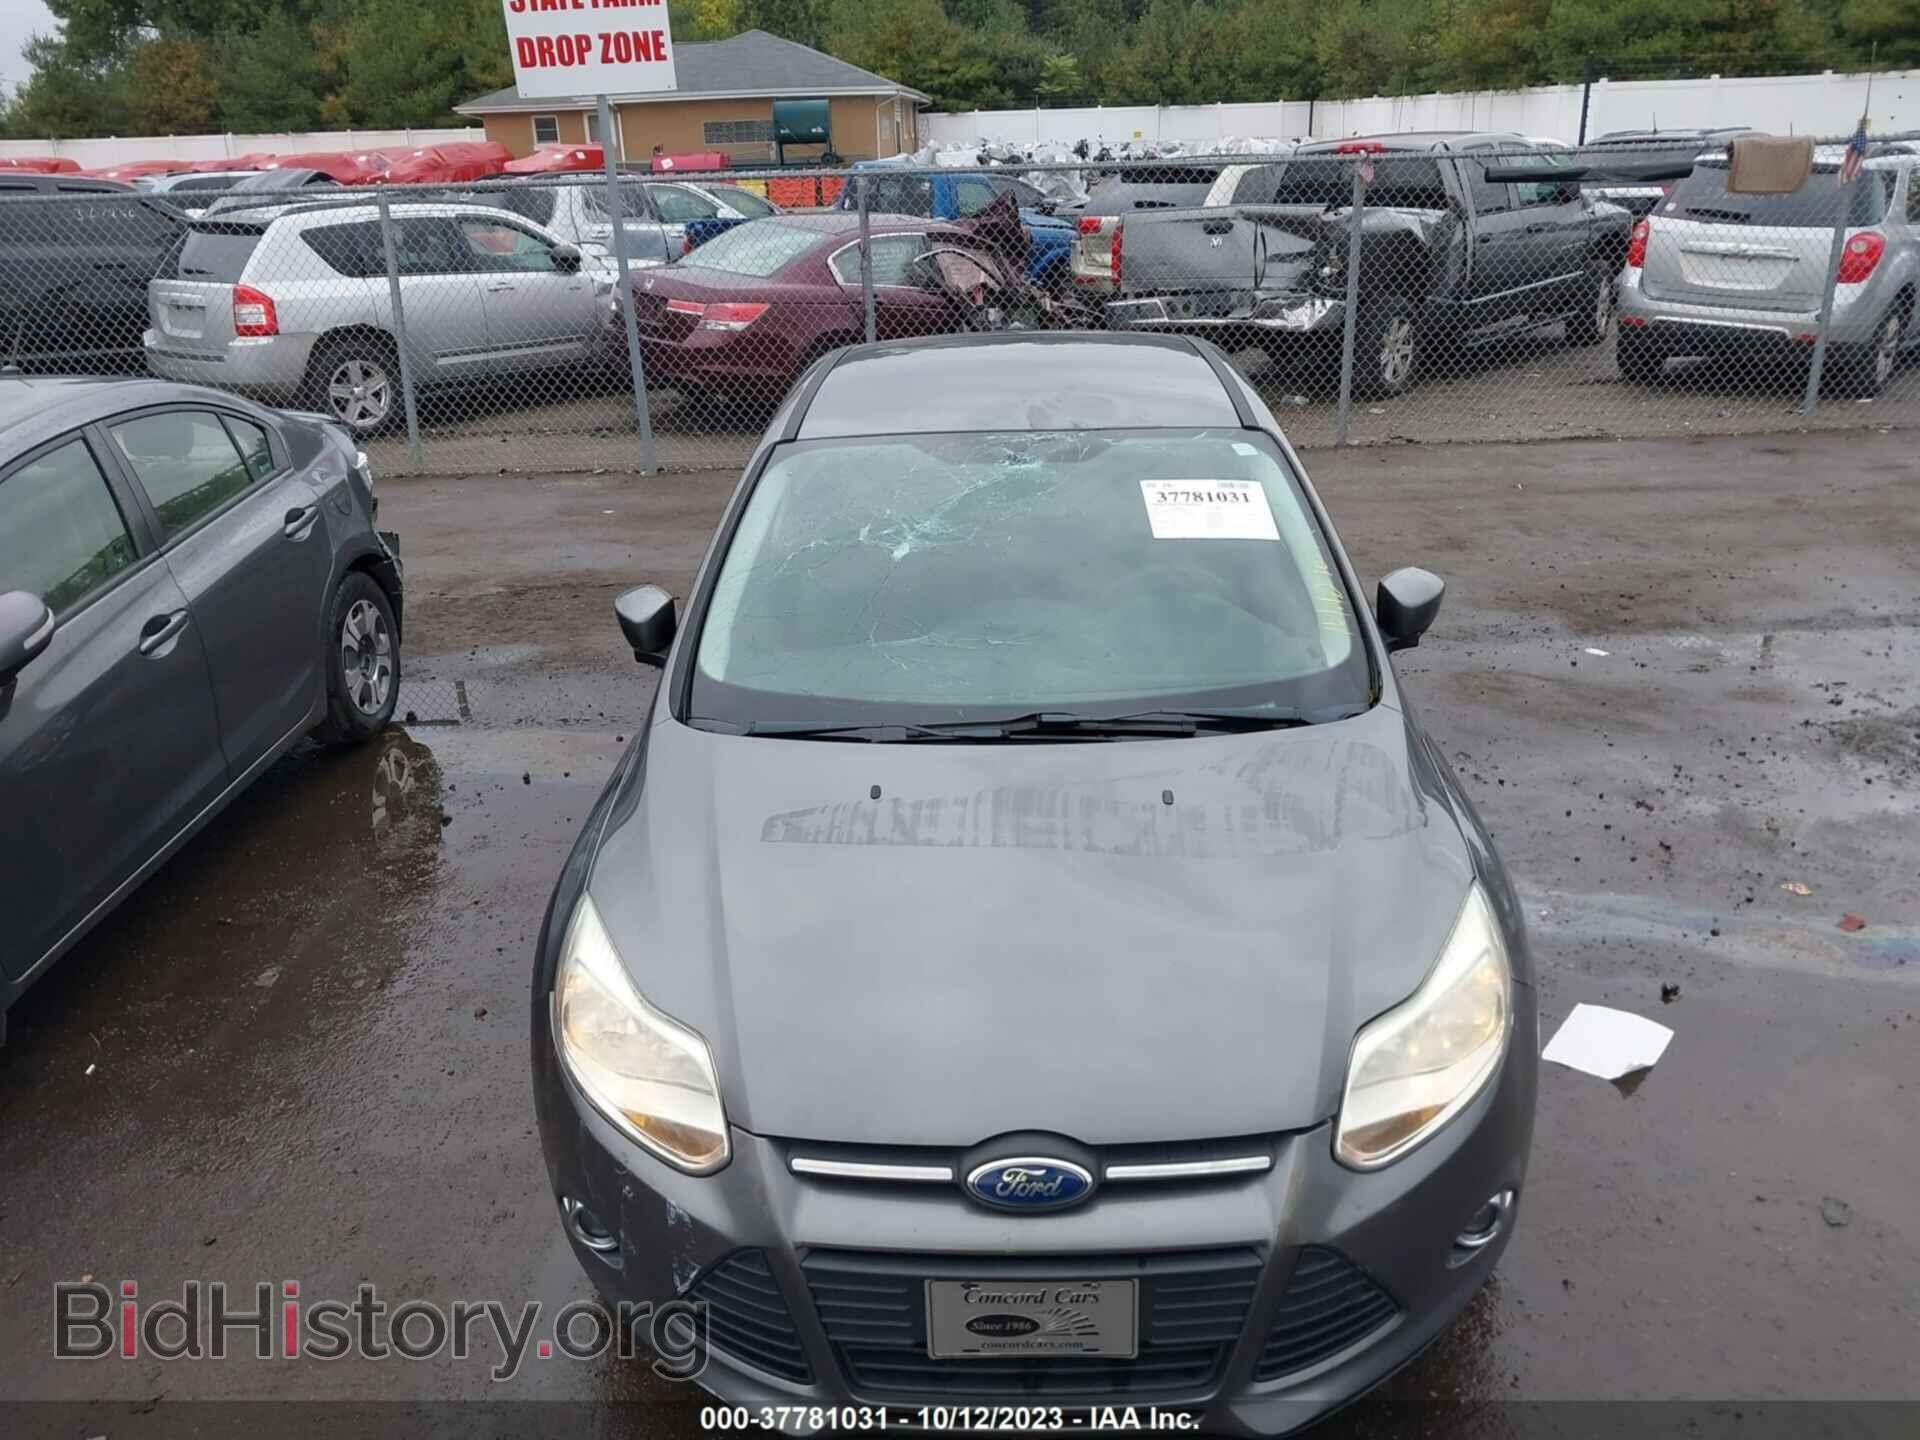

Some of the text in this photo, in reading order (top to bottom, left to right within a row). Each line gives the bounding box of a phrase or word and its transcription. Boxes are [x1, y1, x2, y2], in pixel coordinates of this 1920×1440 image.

[516, 30, 667, 68] DROP ZONE
[1156, 491, 1250, 503] 37781031
[996, 1168, 1063, 1197] Ford
[964, 1288, 1100, 1304] Concord Cars
[971, 1321, 1003, 1330] Since
[981, 1340, 1084, 1349] concordcars.com
